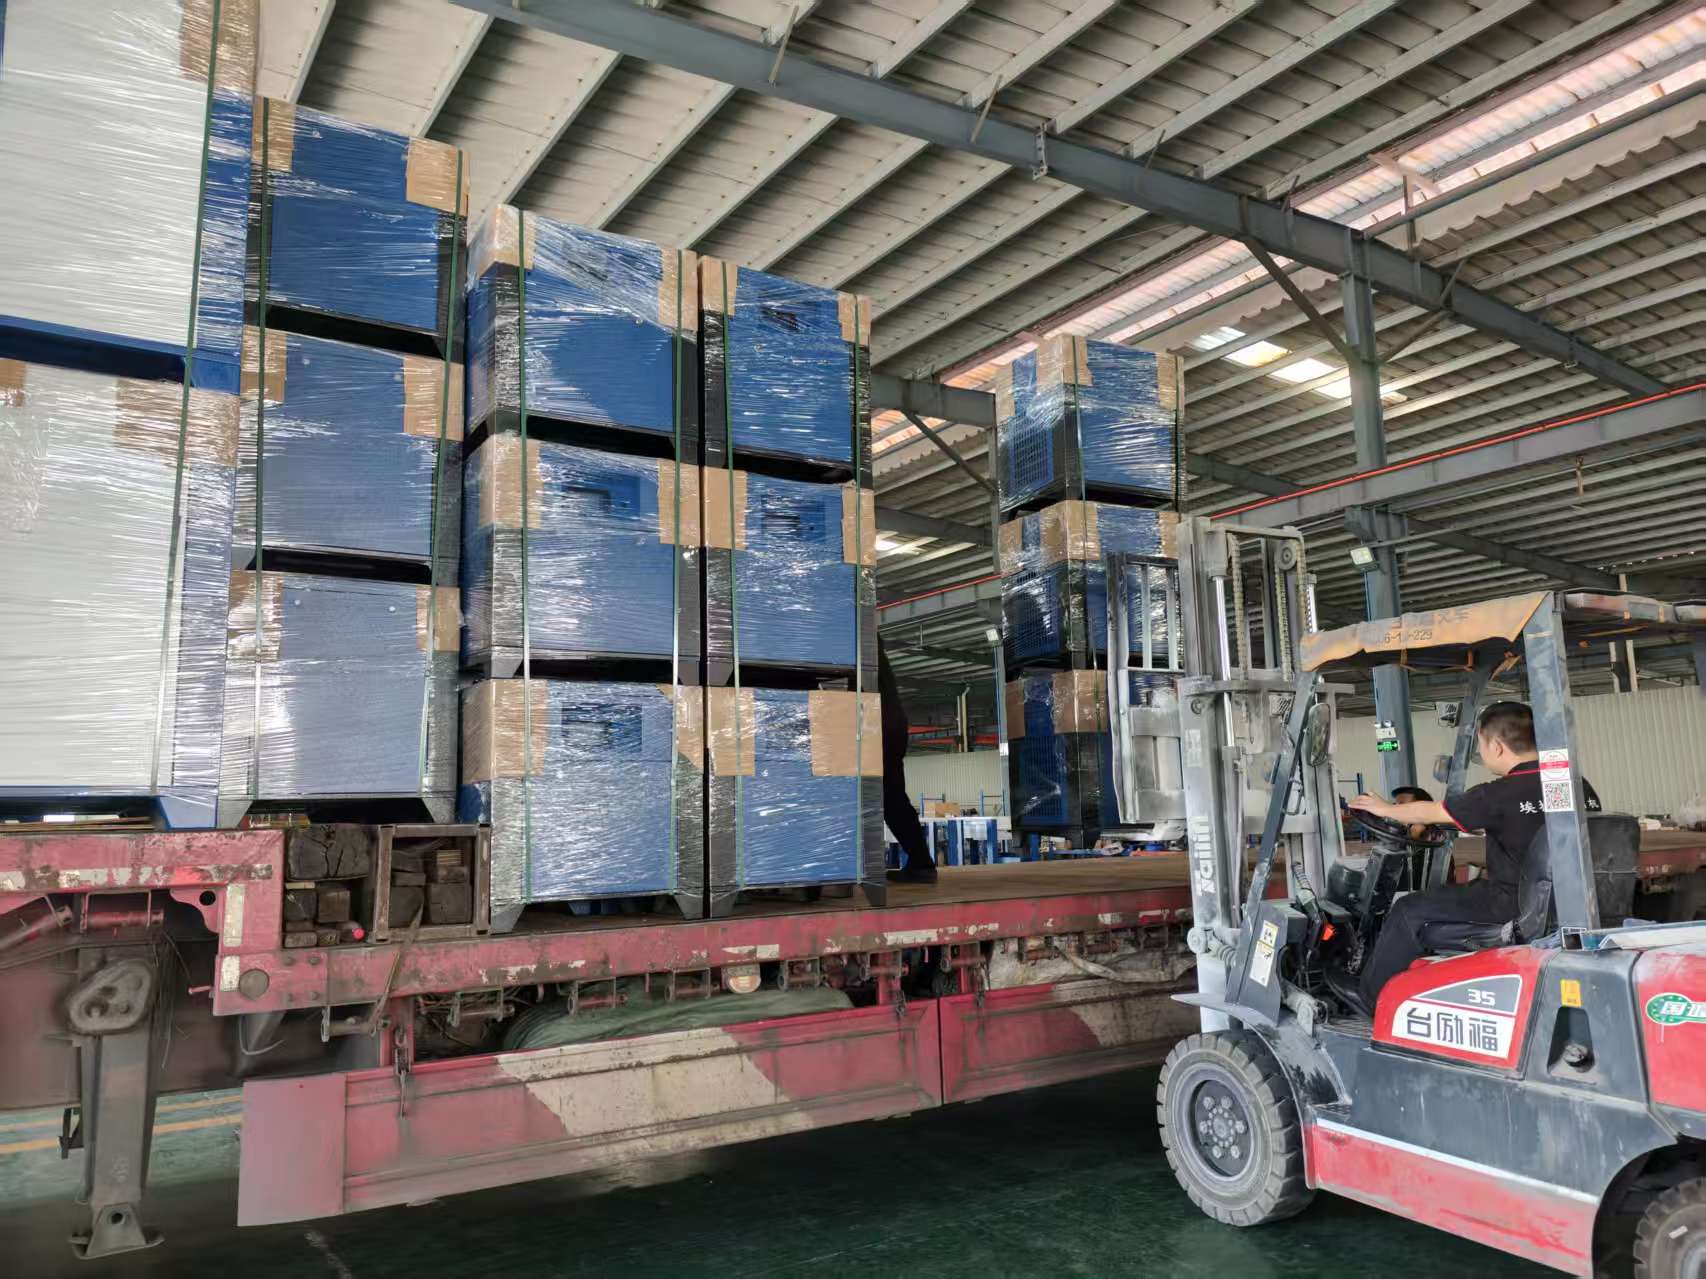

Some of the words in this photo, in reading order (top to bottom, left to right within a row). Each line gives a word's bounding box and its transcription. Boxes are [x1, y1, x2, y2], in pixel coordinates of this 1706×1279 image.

[1467, 988, 1496, 1006] 35
[1406, 1007, 1498, 1052] 台励福
